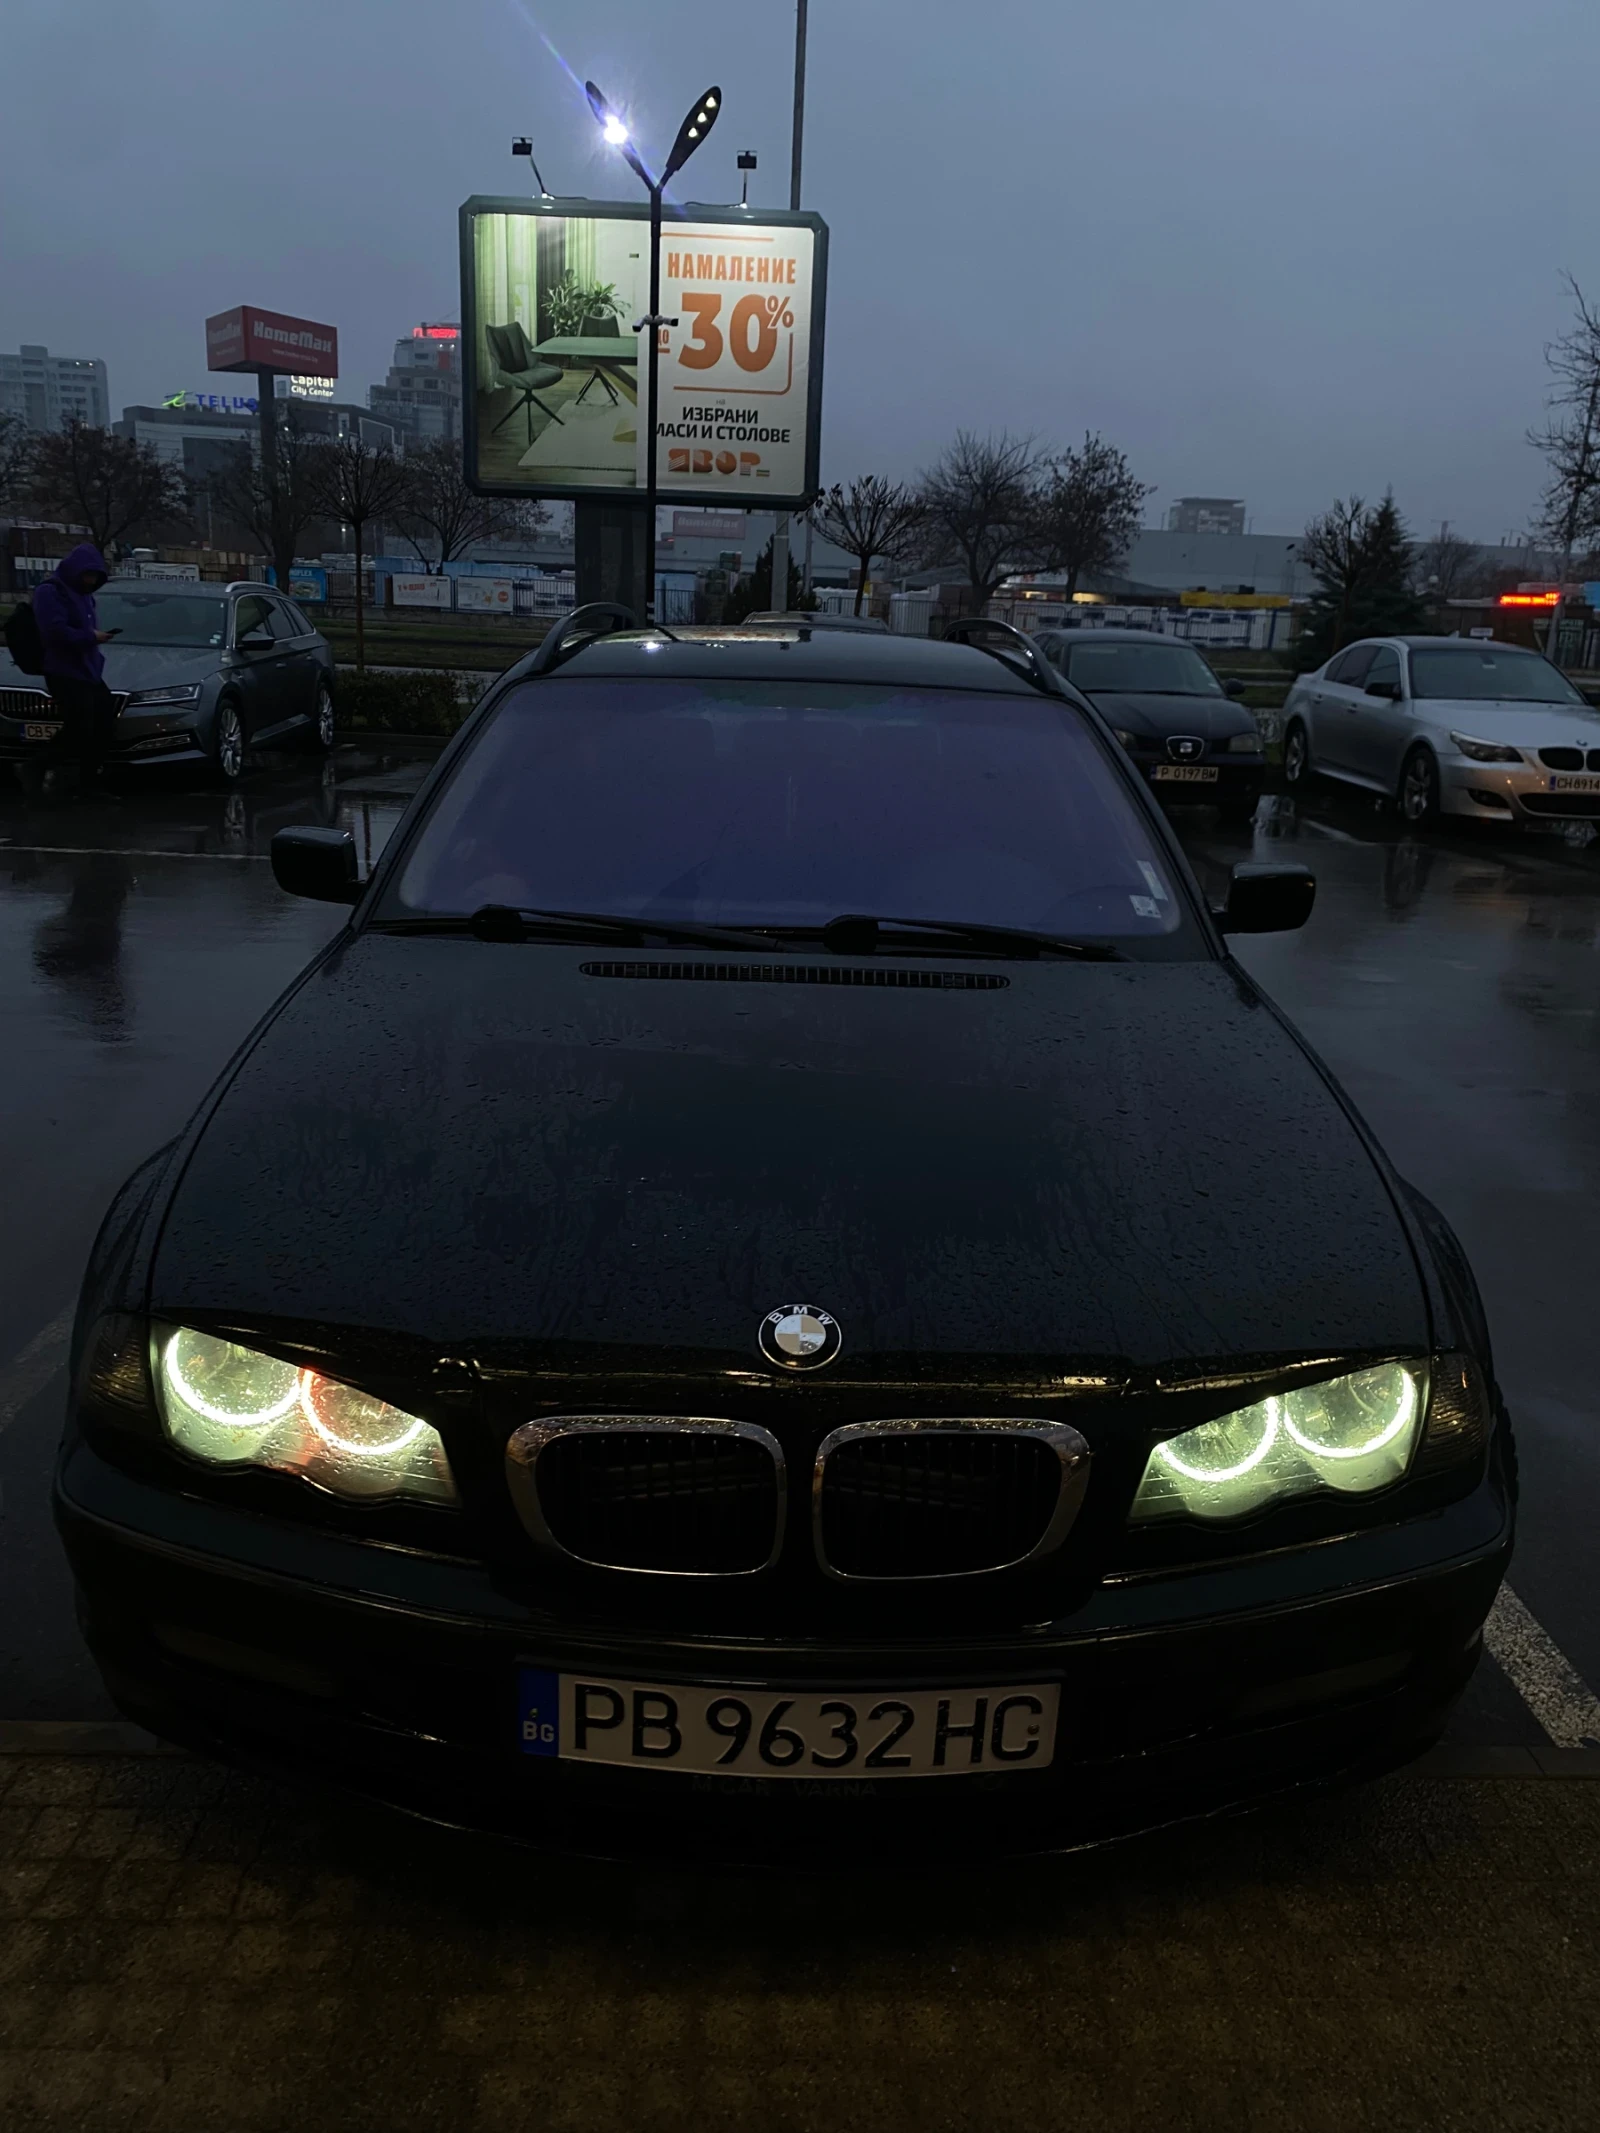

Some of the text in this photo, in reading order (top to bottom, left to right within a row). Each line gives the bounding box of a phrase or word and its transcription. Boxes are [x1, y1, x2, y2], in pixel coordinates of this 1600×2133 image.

[667, 252, 797, 285] НАМАЛЕНИЕ
[253, 320, 333, 353] HomeMax
[678, 292, 795, 373] 30%
[291, 385, 334, 398] City Center
[195, 394, 260, 412] TELUS
[682, 406, 759, 425] ИЗБРАНИ
[701, 424, 713, 440] И
[716, 425, 791, 444] СТОЛОВЕ
[668, 448, 761, 476] ЯВОР
[27, 725, 43, 738] CB
[1161, 767, 1169, 779] P
[1173, 767, 1200, 780] 0197
[767, 1305, 834, 1326] BMW
[521, 1719, 556, 1745] BG
[574, 1682, 1043, 1769] PB 9632 HC
